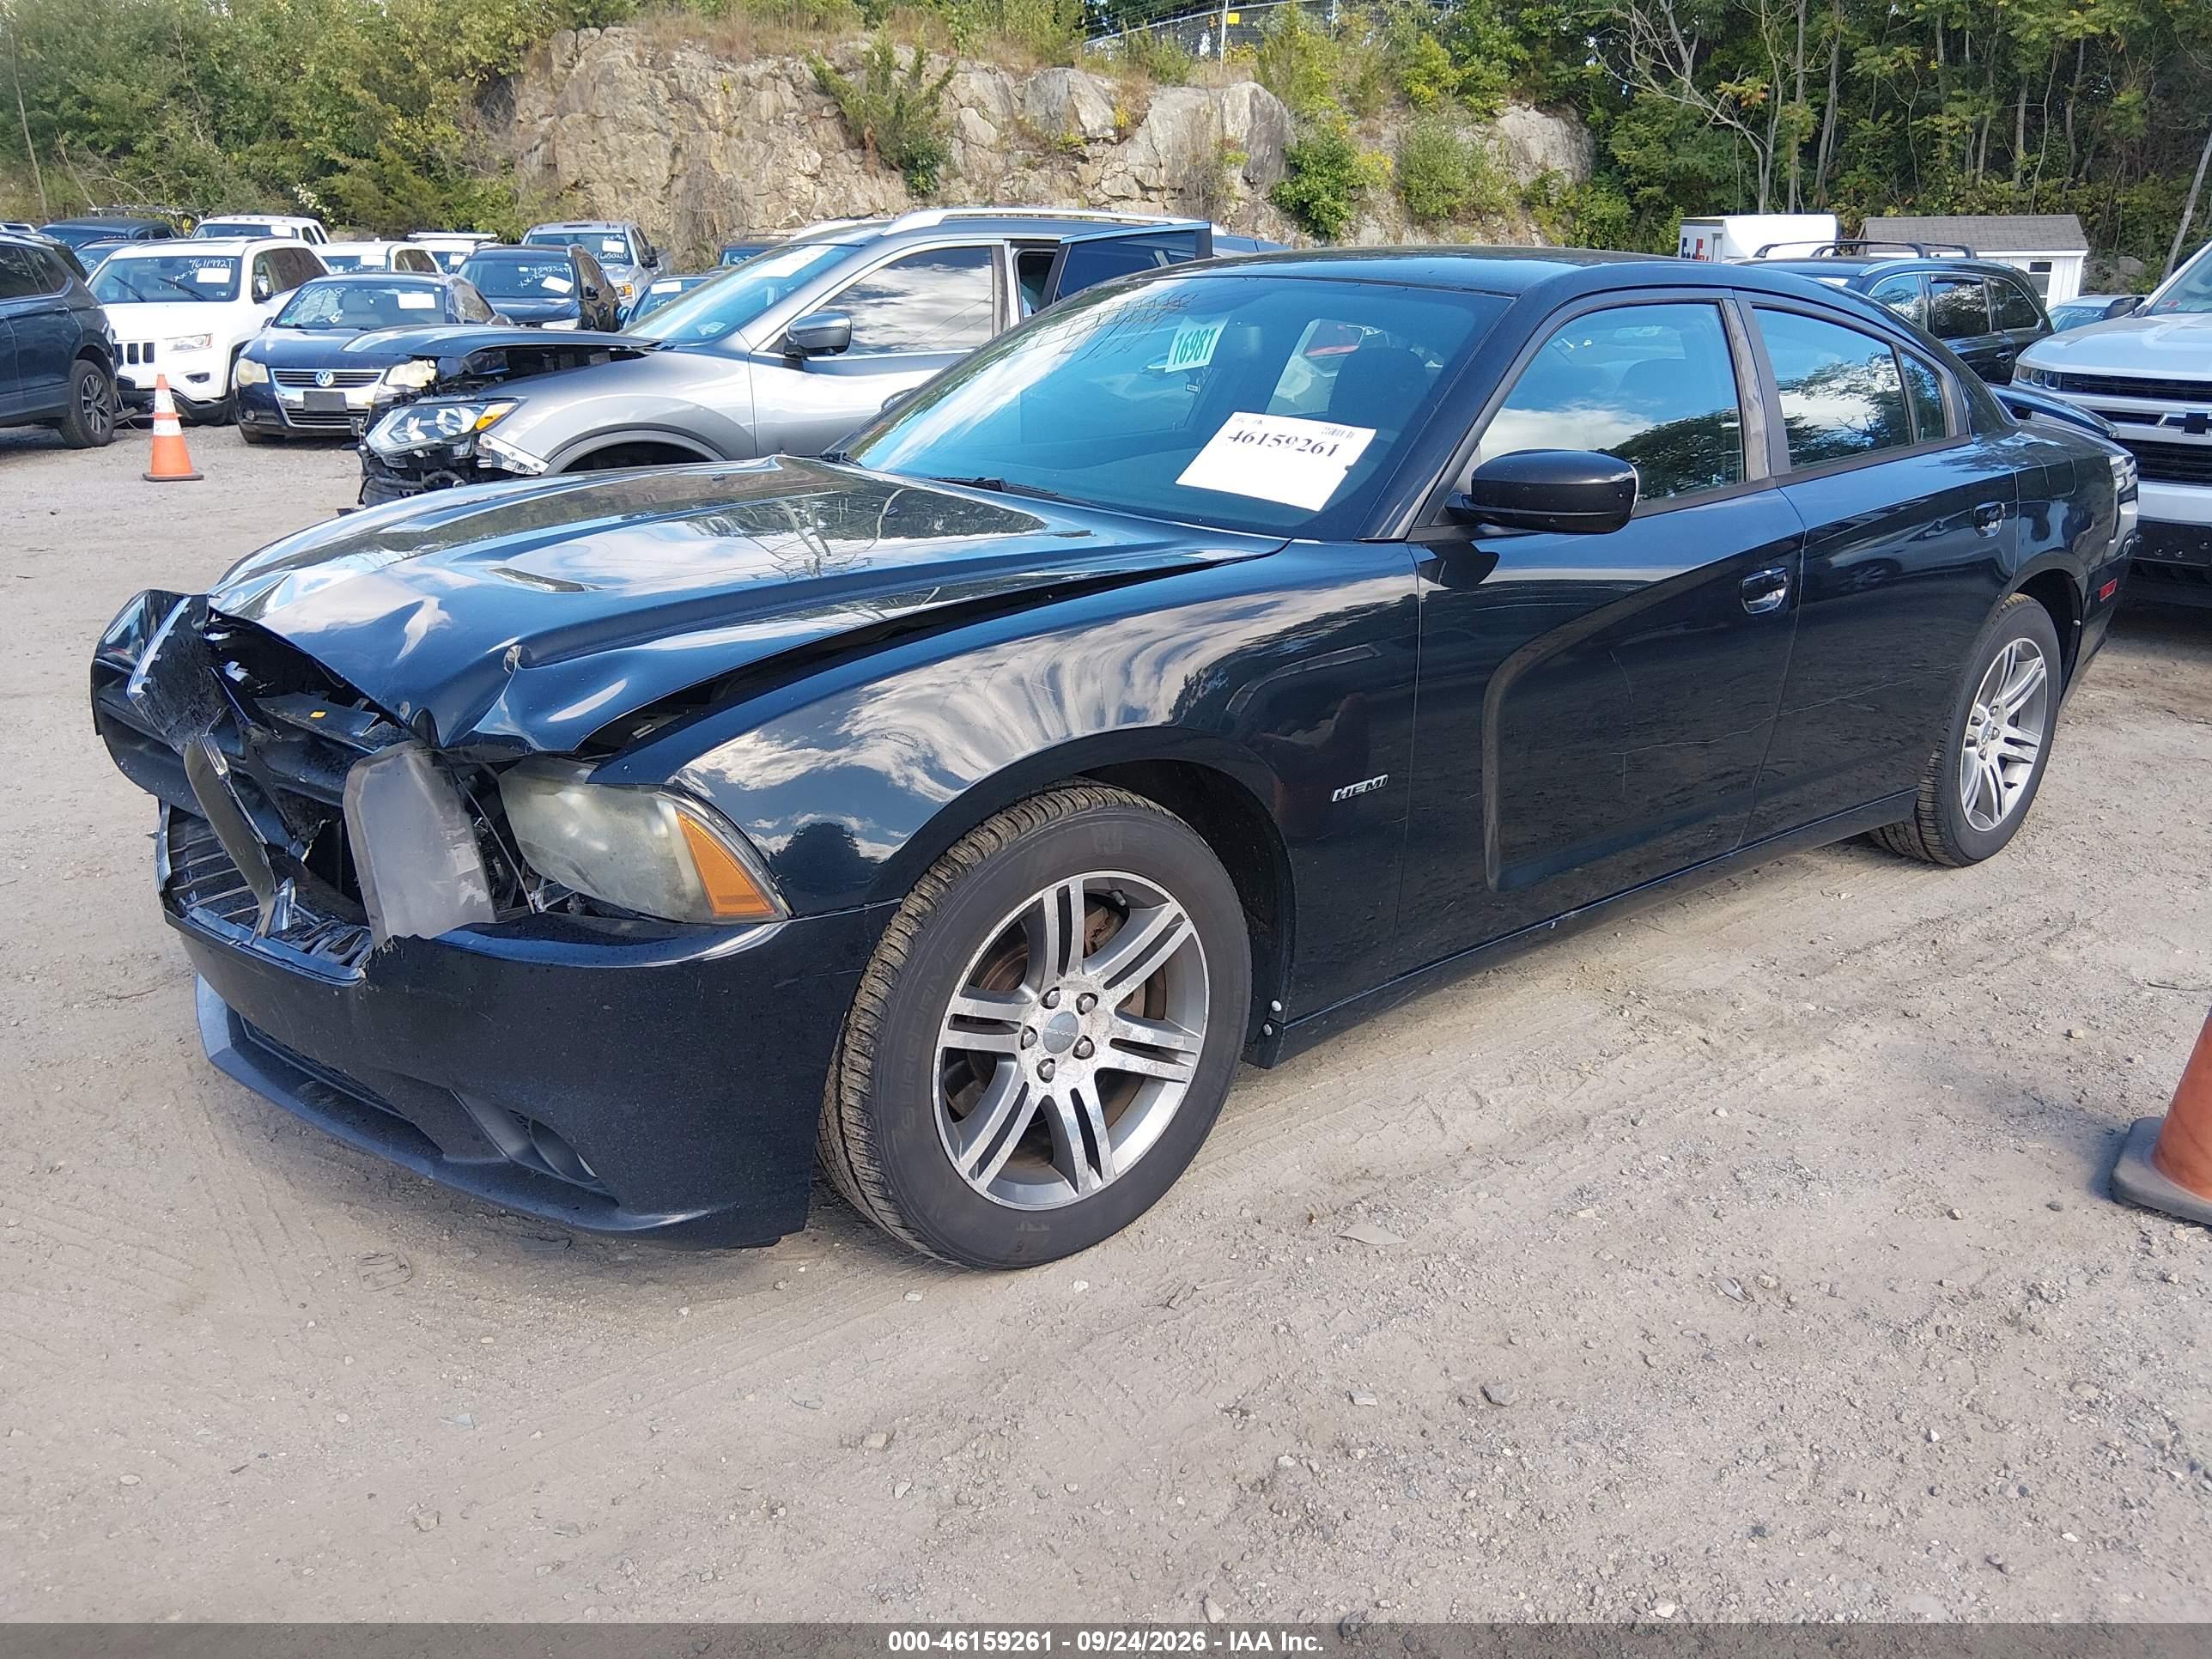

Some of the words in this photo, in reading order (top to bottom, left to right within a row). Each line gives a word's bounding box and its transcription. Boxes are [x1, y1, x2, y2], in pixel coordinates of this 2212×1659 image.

[1173, 327, 1218, 366] 16981
[1228, 429, 1340, 457] 46159261
[1332, 774, 1389, 802] HEMI
